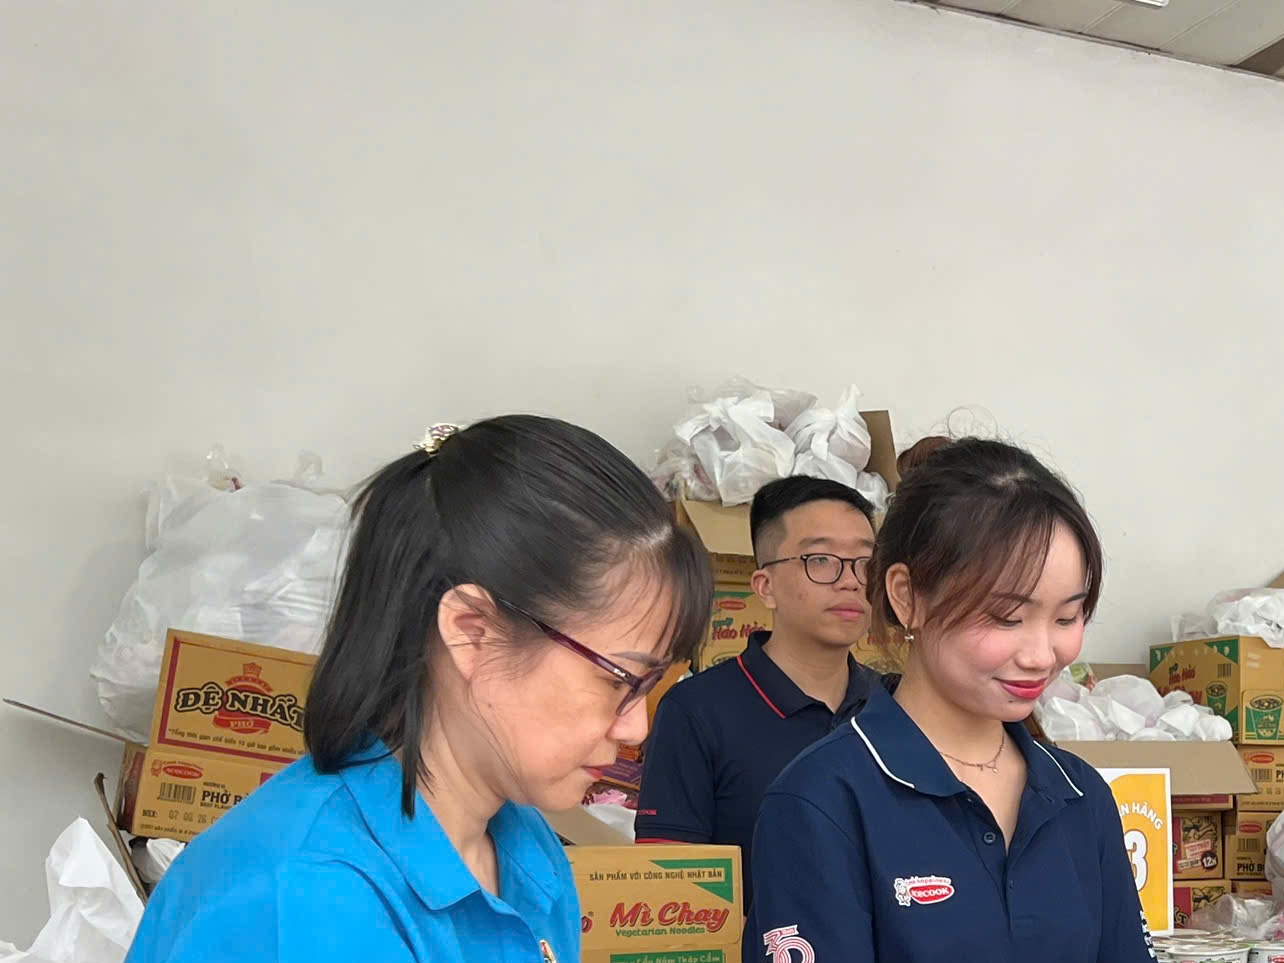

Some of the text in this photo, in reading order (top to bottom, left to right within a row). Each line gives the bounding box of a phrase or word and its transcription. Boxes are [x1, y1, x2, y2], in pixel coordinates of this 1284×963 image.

[1124, 829, 1148, 893] 3
[609, 901, 655, 928] Mì
[658, 901, 730, 933] Chay
[616, 926, 706, 938] Vegetarian Noodles
